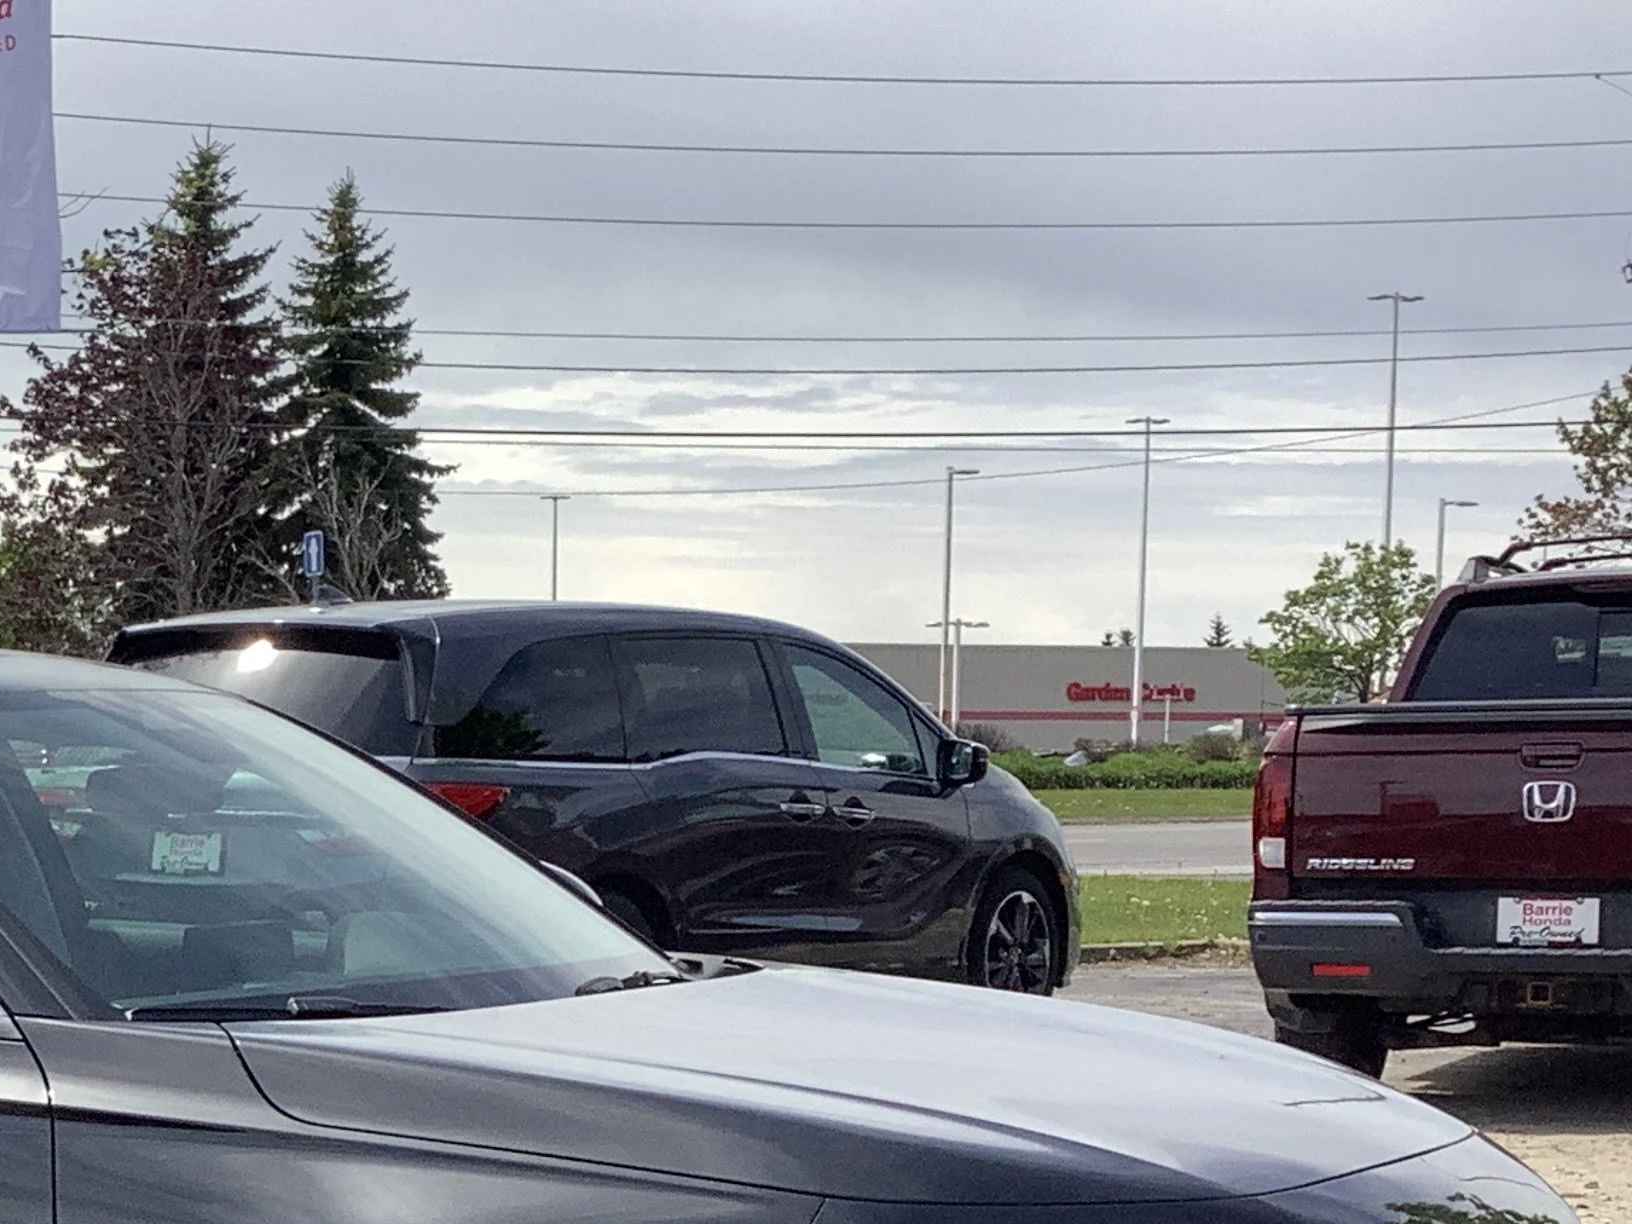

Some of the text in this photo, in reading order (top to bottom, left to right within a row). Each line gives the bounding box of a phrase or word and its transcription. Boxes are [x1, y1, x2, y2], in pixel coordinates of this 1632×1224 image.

[1067, 682, 1131, 702] Garden
[1306, 858, 1415, 871] RIDGELINE
[1522, 903, 1573, 917] Barrie
[1522, 916, 1572, 927] Honda
